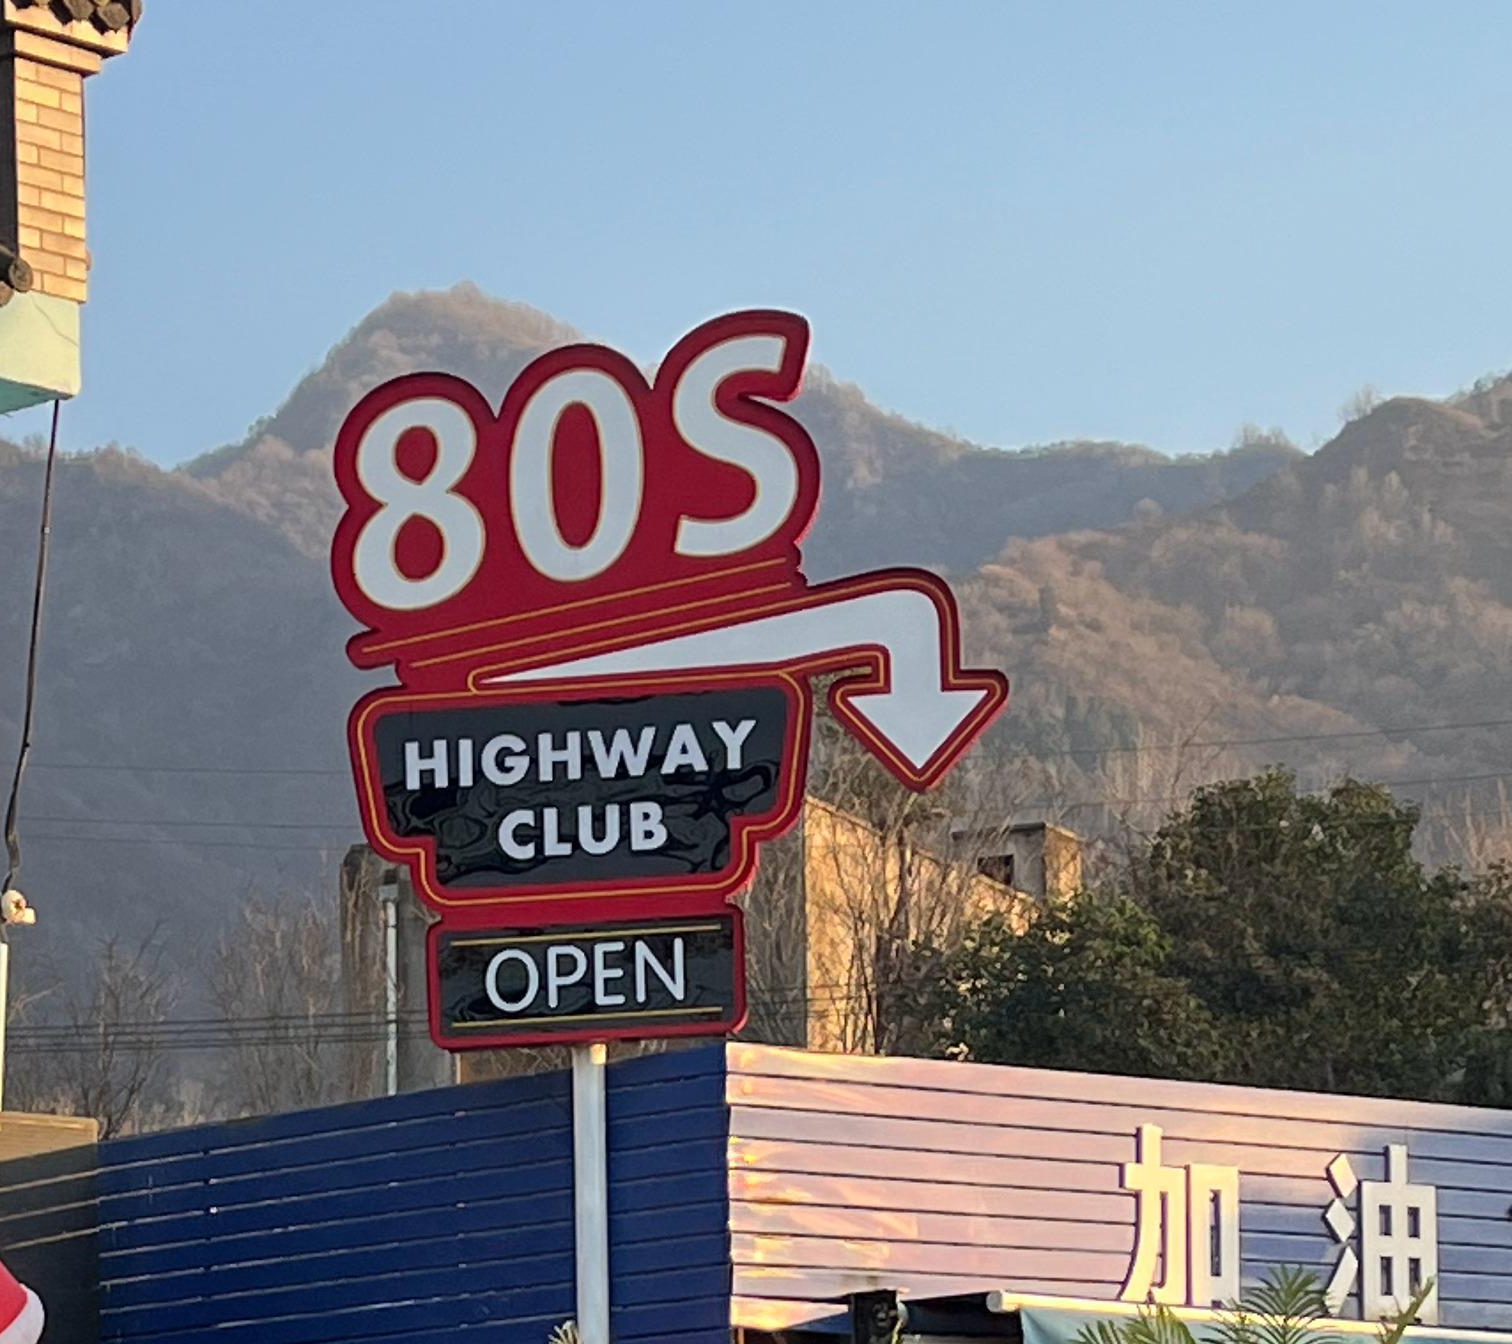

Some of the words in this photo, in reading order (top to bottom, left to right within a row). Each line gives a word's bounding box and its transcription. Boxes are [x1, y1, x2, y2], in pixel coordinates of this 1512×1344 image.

[353, 334, 799, 610] 80S
[403, 718, 756, 791] HIGHWAY
[497, 801, 668, 861] CLUB
[486, 936, 686, 1012] OPEN
[1118, 1123, 1439, 1325] 加油
